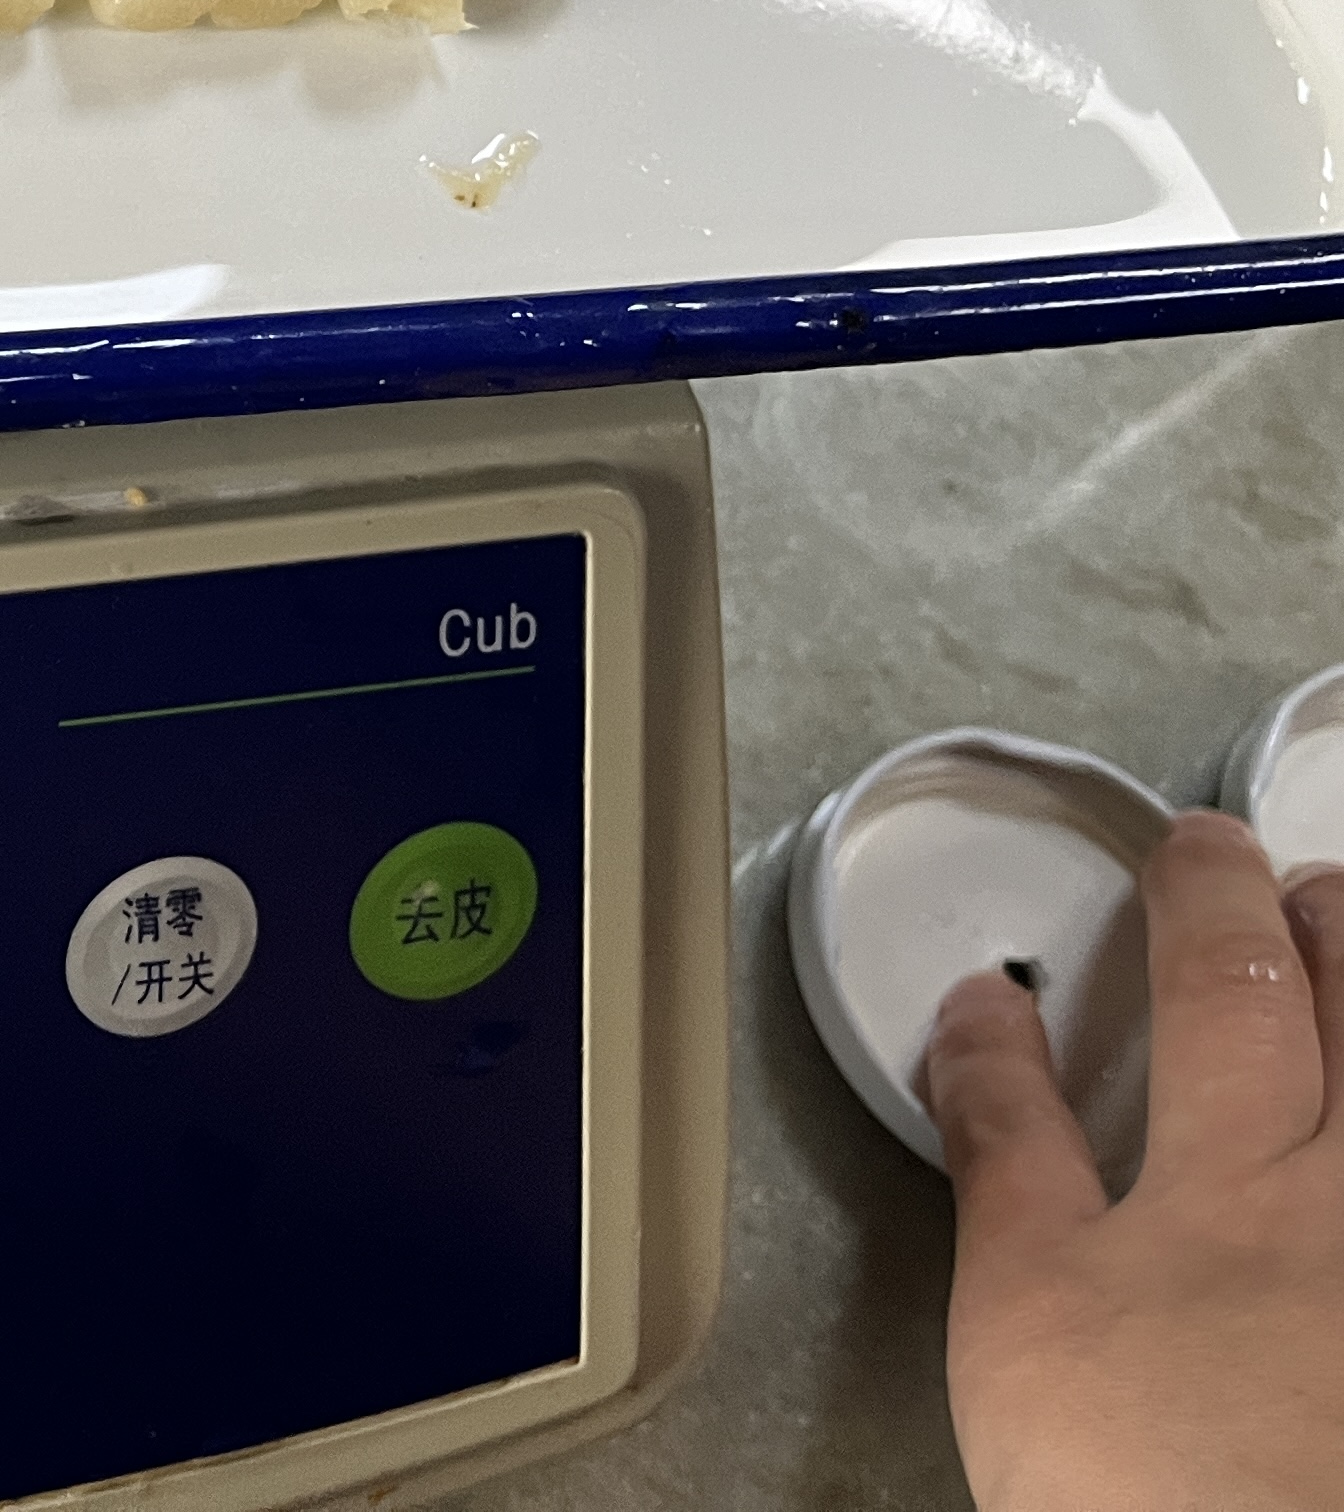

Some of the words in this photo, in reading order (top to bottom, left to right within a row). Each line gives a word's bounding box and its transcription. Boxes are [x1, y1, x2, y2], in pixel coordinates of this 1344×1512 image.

[438, 603, 538, 657] Cub
[122, 887, 203, 944] 清零
[395, 879, 493, 945] 去皮
[112, 952, 214, 1006] /开关
